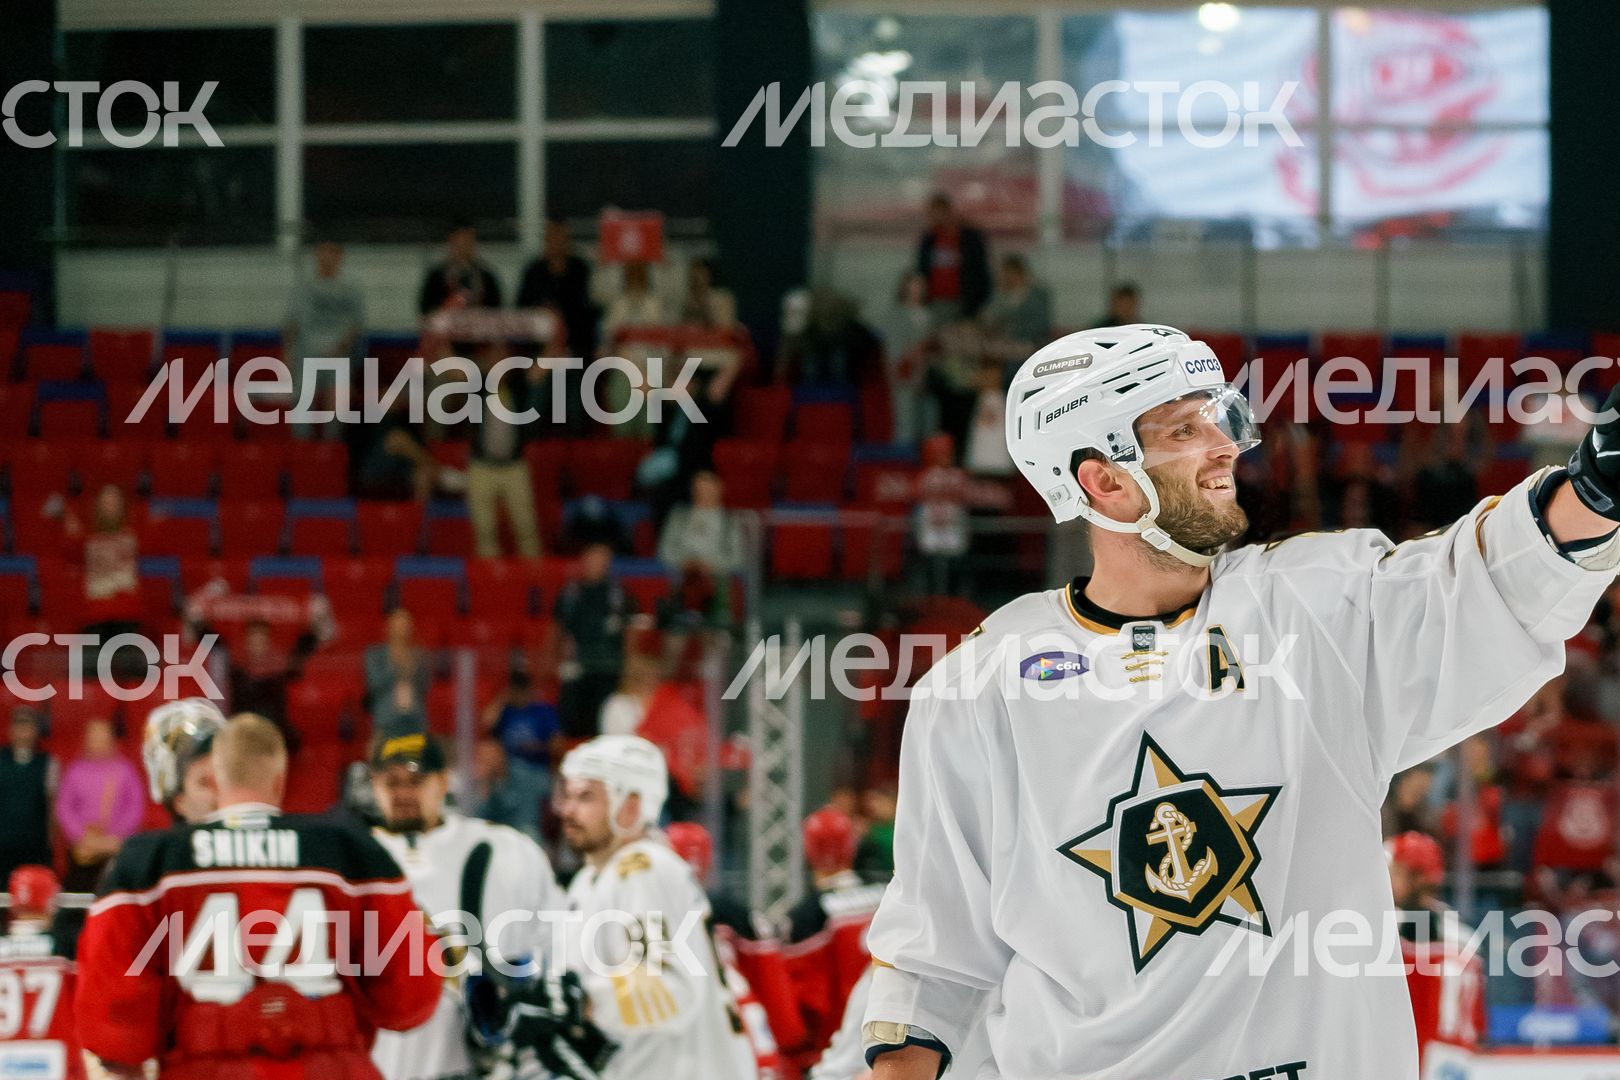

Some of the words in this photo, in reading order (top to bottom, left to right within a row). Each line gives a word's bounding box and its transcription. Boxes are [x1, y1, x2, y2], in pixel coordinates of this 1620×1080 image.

[1037, 357, 1089, 374] OLIMPBET
[1207, 623, 1245, 696] A
[174, 887, 343, 1005] 44
